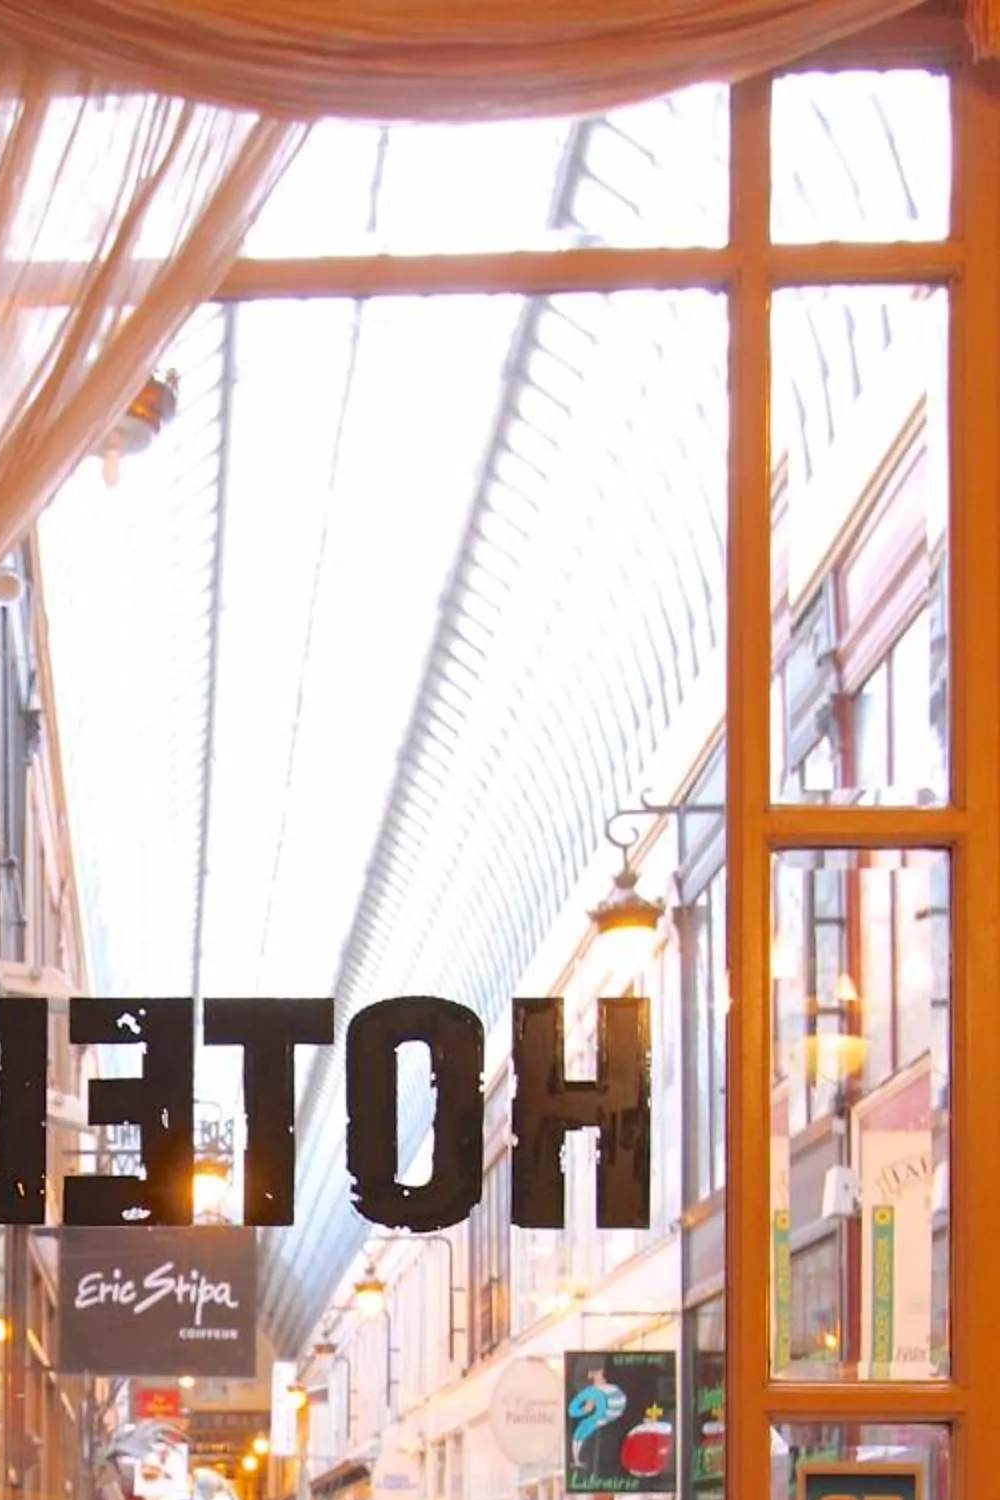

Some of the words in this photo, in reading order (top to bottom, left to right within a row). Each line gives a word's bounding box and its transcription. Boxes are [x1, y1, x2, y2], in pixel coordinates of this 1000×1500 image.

[74, 1267, 137, 1309] Eric
[133, 1261, 239, 1326] Stipa
[178, 1327, 239, 1340] COIFFEUR
[568, 1470, 641, 1490] Librairie
